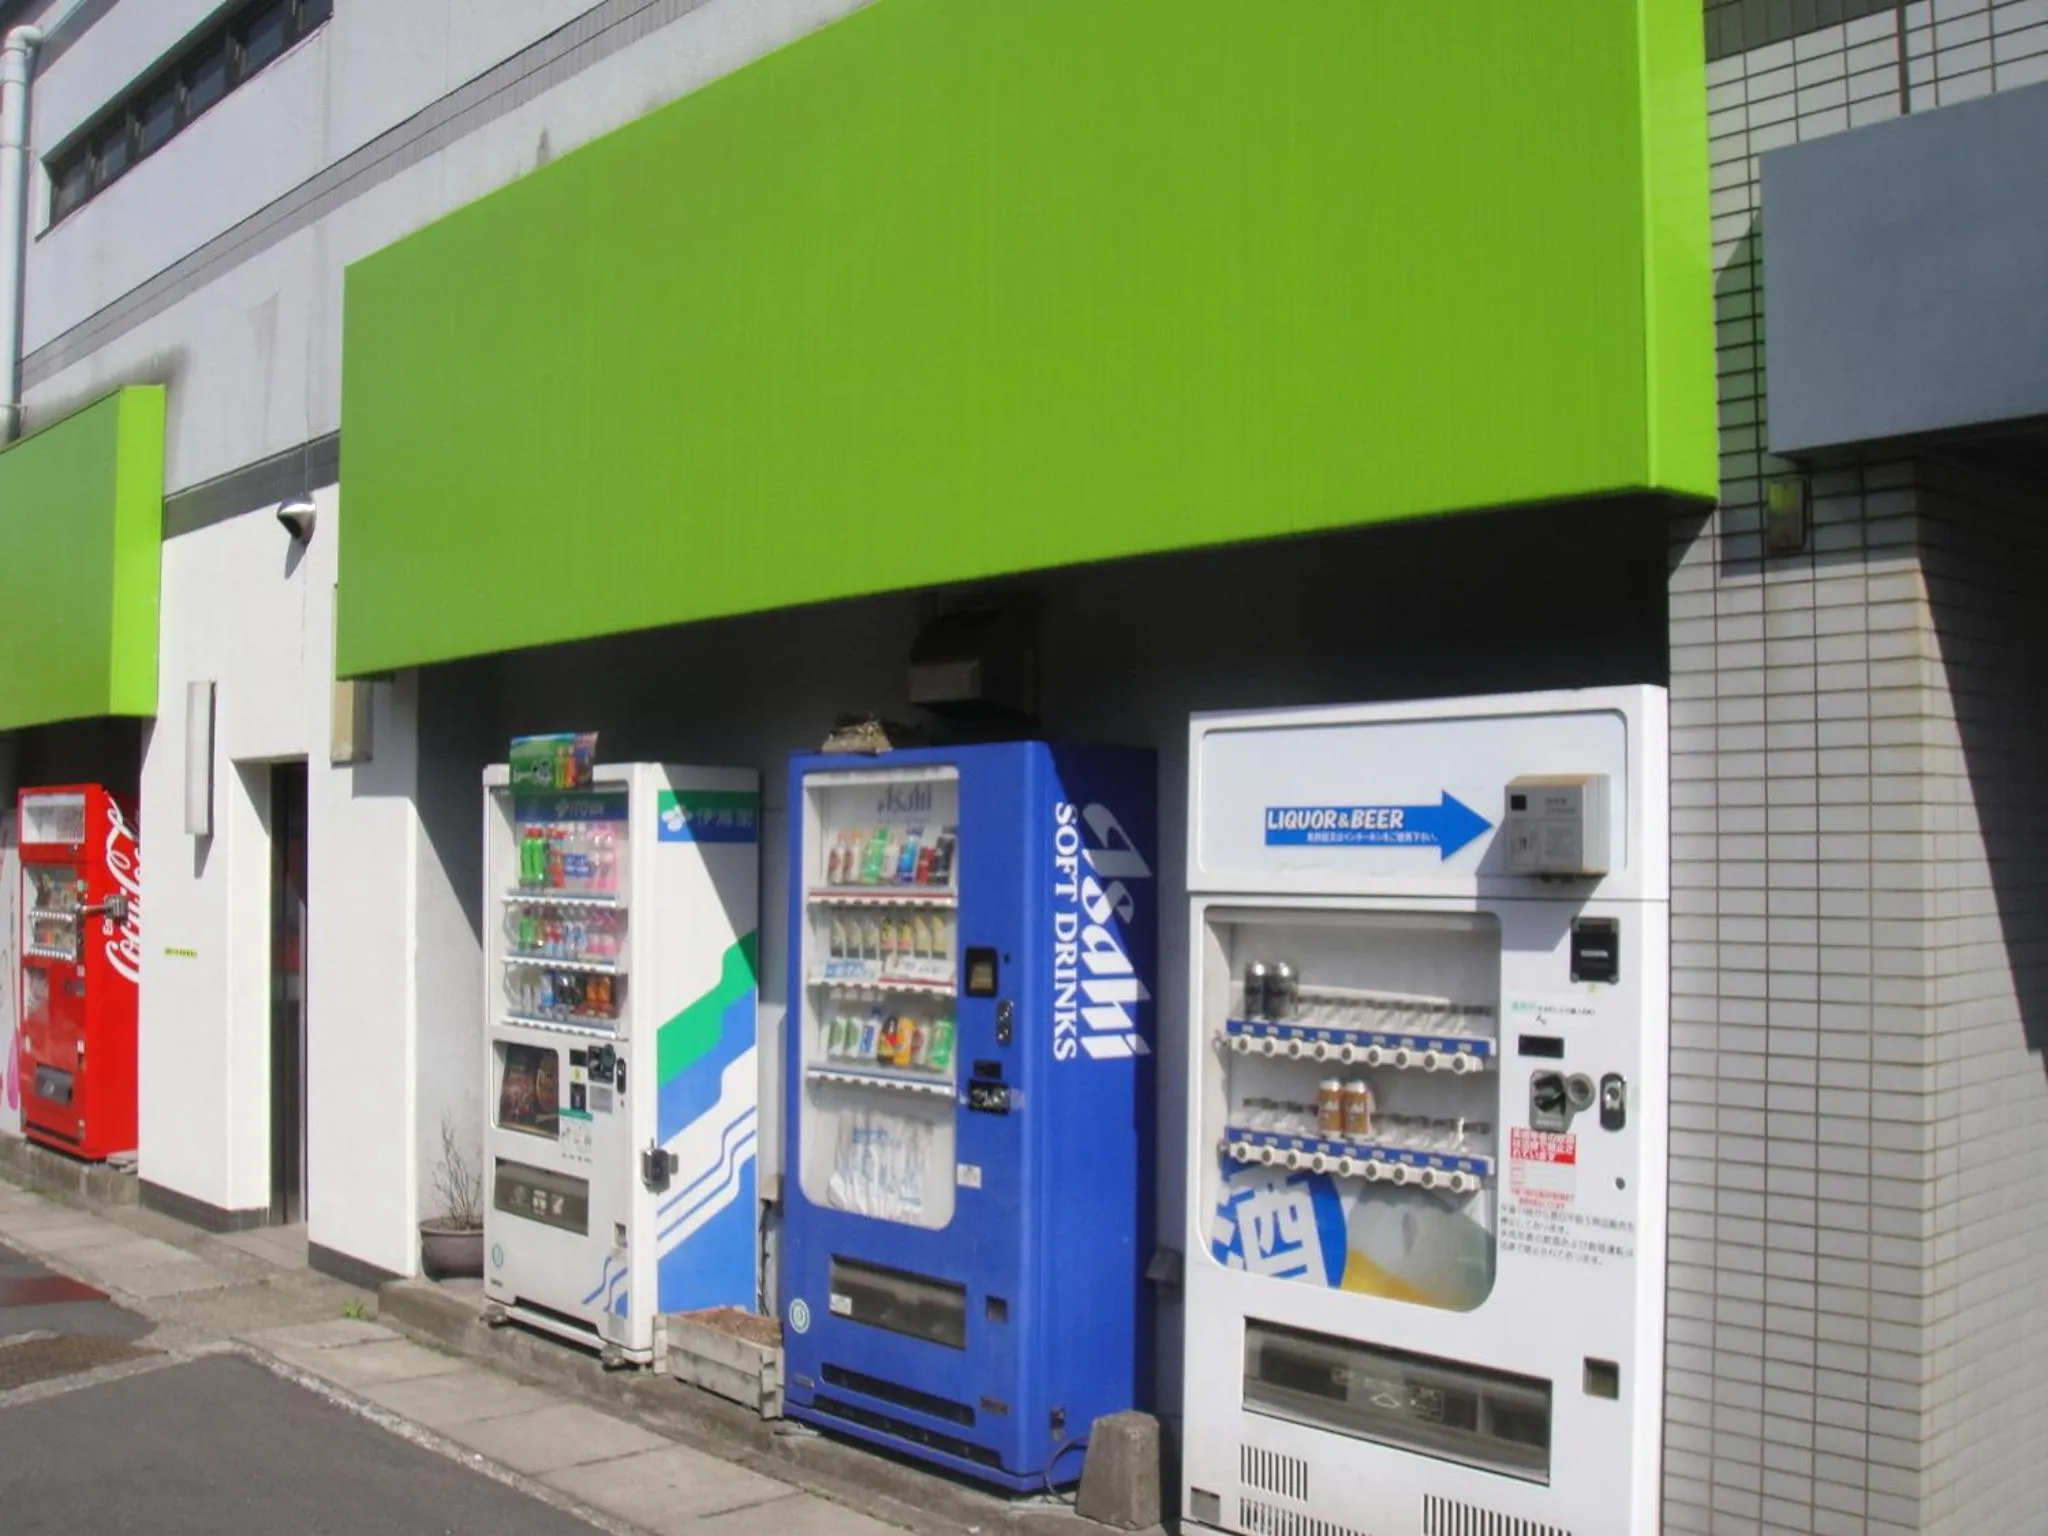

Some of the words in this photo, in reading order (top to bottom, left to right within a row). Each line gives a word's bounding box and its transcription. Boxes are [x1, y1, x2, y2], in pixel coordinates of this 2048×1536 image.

[1054, 802, 1079, 902] SOFT
[1053, 912, 1078, 1061] DRINKS
[1080, 802, 1152, 1060] Asahi
